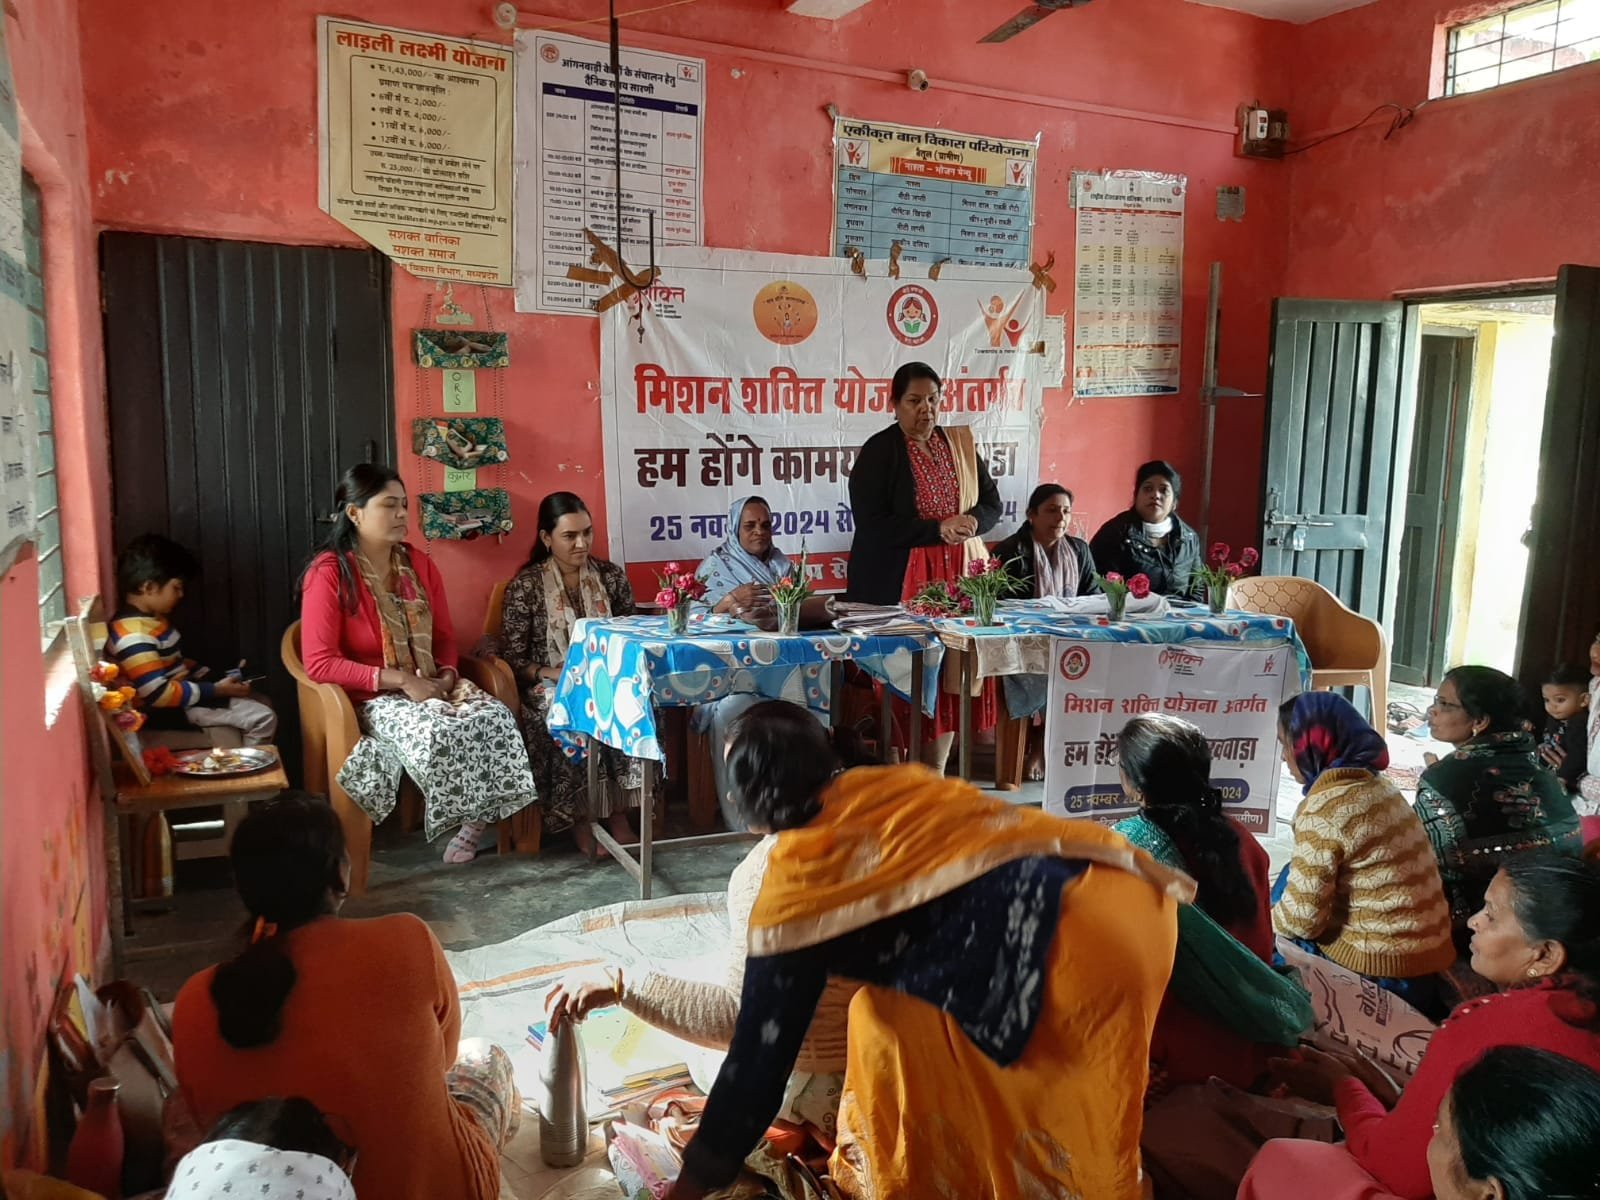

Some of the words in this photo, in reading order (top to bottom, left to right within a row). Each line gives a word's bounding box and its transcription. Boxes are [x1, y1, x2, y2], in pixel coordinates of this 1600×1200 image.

[336, 31, 395, 53] लाड़ली
[399, 40, 448, 61] लक्ष्मी
[452, 46, 506, 72] योजना
[562, 58, 601, 74] आंगनवाड़ी
[634, 69, 663, 82] संचालन
[584, 74, 608, 86] दैनिक
[630, 83, 654, 94] सारणी
[843, 124, 893, 143] एकीकृत
[896, 132, 921, 144] बाल
[925, 133, 966, 149] विकास
[969, 139, 1030, 158] परियोजना
[388, 229, 421, 241] सशक्त
[392, 245, 424, 257] सशक्त
[428, 248, 456, 260] समाज
[634, 363, 732, 415] मिशन
[740, 366, 826, 415] शक्ति
[834, 366, 893, 414] योज
[634, 447, 690, 488] हम
[699, 432, 763, 486] होंगे
[770, 446, 862, 484] कामय
[650, 515, 682, 541] 25
[770, 510, 830, 536] 2024
[1064, 692, 1114, 713] मिशन
[1121, 693, 1160, 713] शक्ति
[1164, 691, 1219, 713] योजना
[1064, 741, 1090, 766] हम
[1094, 732, 1120, 765] हों
[1205, 737, 1259, 768] खवाड़ा
[1070, 795, 1082, 809] 25
[1217, 786, 1241, 799] 024
